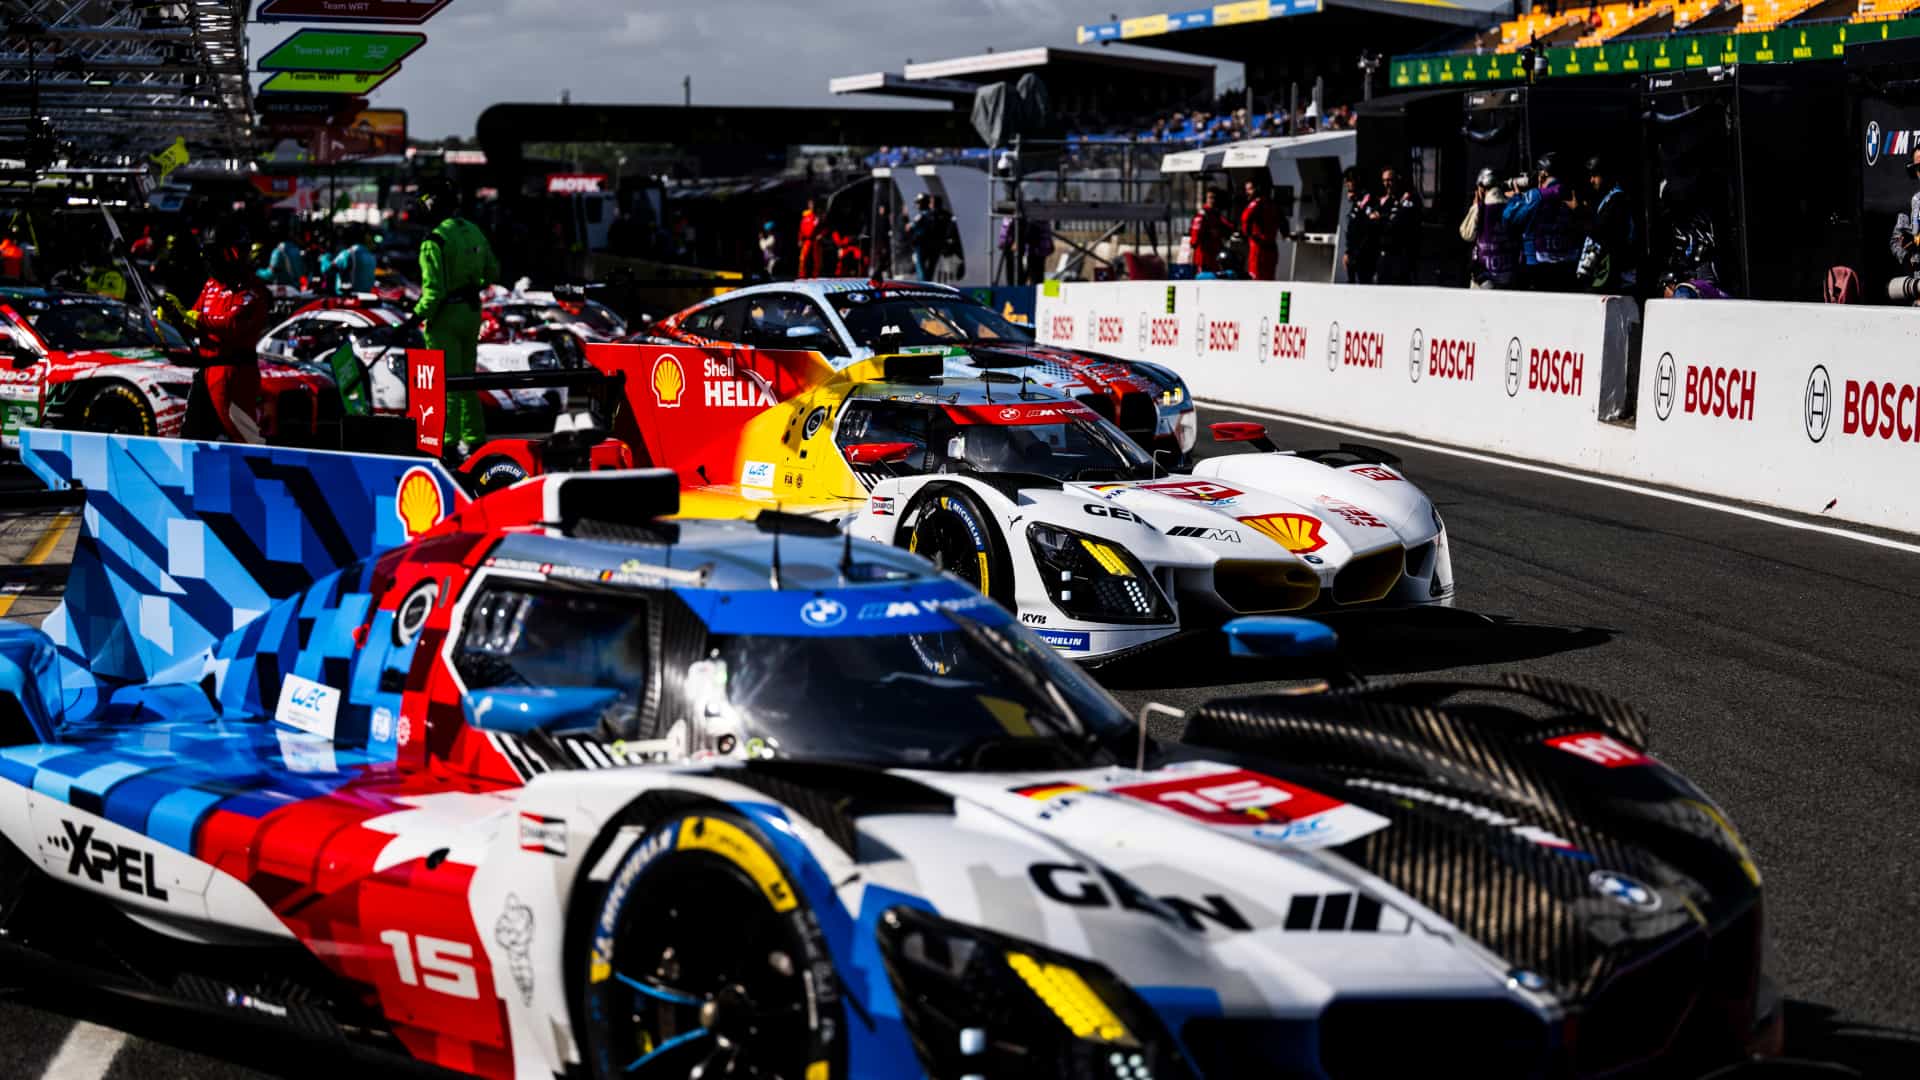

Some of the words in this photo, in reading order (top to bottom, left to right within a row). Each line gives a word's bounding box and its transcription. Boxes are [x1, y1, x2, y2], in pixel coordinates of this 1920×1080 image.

[322, 1, 346, 10] Team
[348, 2, 369, 11] WRT
[294, 45, 322, 56] Team
[325, 46, 352, 57] WRT
[1099, 317, 1123, 343] BOSCH
[1152, 318, 1179, 346] BOSCH
[1209, 320, 1240, 351] BOSCH
[1273, 324, 1307, 360] BOSCH
[1344, 330, 1384, 369] BOSCH
[1429, 338, 1477, 381] BOSCH
[417, 364, 435, 390] HY
[704, 357, 735, 377] Shell
[1528, 348, 1584, 397] BOSCH
[704, 374, 778, 407] HELIX
[1684, 365, 1757, 421] BOSCH
[952, 502, 982, 546] MICHELIN
[1558, 736, 1641, 763] HY
[1159, 780, 1293, 813] 15
[61, 819, 169, 902] XPEL
[380, 929, 481, 1000] 15
